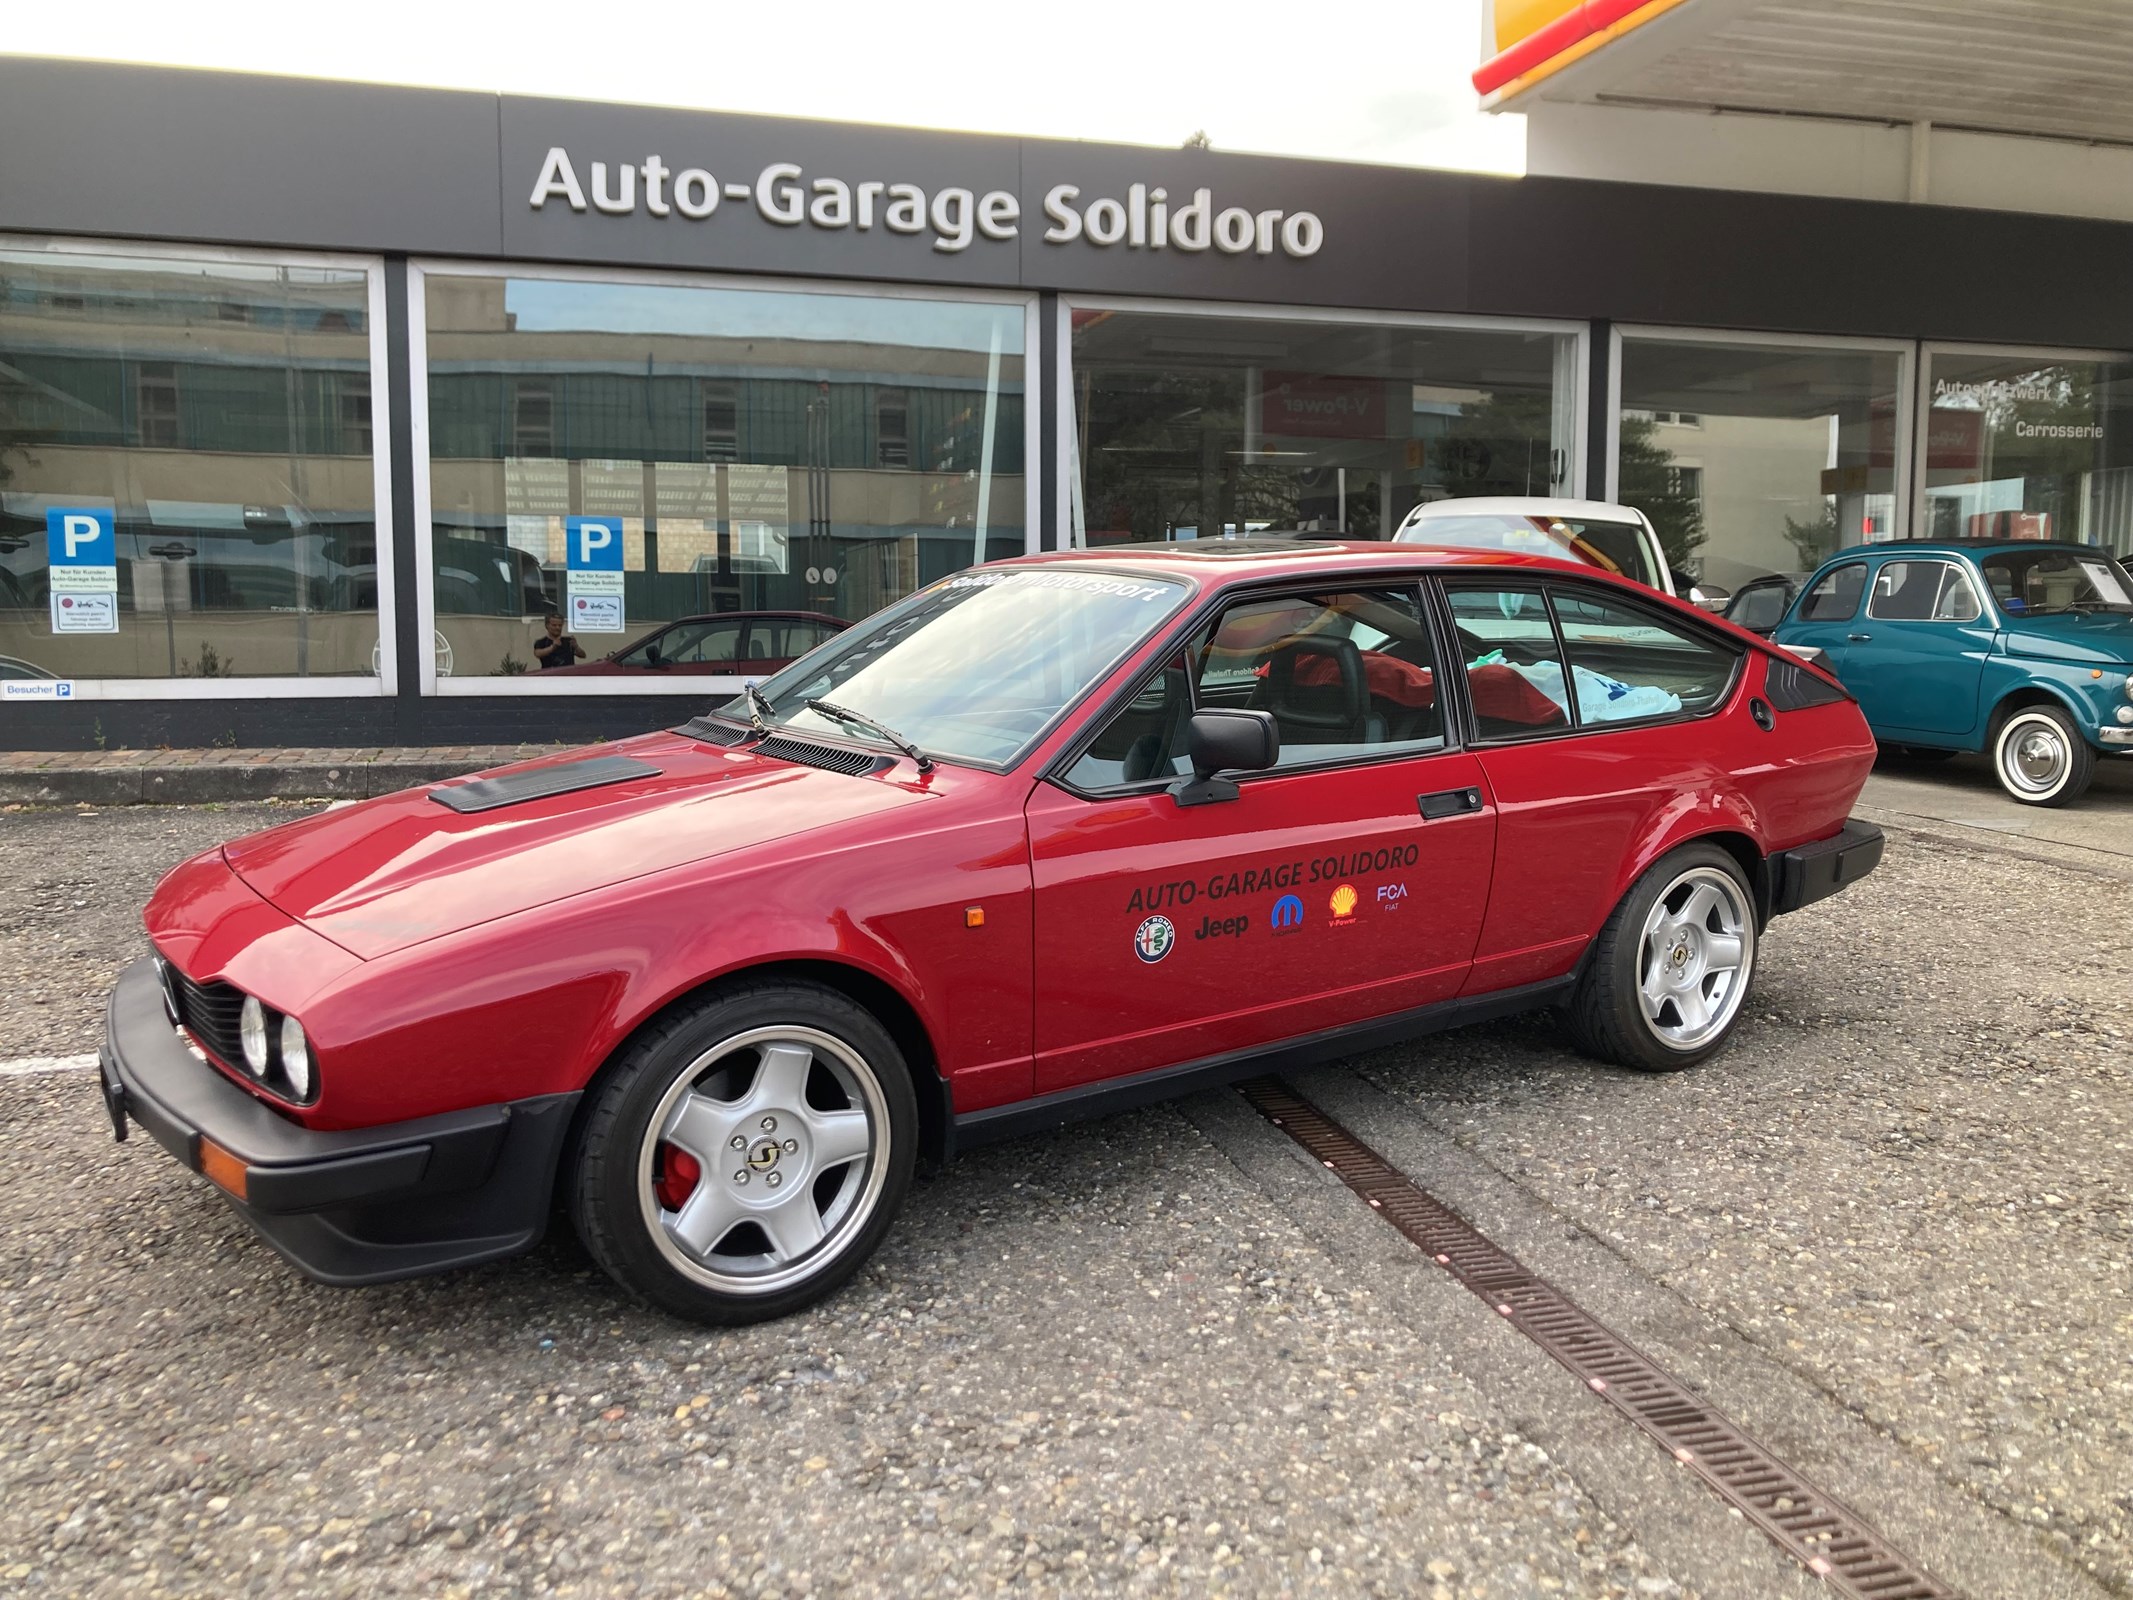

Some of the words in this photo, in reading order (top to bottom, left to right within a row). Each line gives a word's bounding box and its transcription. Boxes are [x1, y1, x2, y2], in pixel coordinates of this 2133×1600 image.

[530, 146, 1019, 253] Auto-Garage
[1043, 182, 1324, 258] Solidoro
[2016, 421, 2103, 438] Carrosserie
[64, 515, 100, 557] P
[580, 523, 612, 563] P
[1024, 573, 1170, 601] Motorsport
[7, 685, 53, 694] Besucher
[1583, 702, 1606, 713] Garage
[1126, 862, 1304, 913] AUTO-GARAGE
[1309, 844, 1419, 882] SOLIDORO
[1377, 882, 1408, 902] FCA
[1384, 902, 1399, 912] FIAT
[1136, 921, 1150, 943] ALFA
[1152, 917, 1174, 938] ROMEO
[1194, 915, 1249, 940] Jeep
[1328, 917, 1357, 928] V-Power
